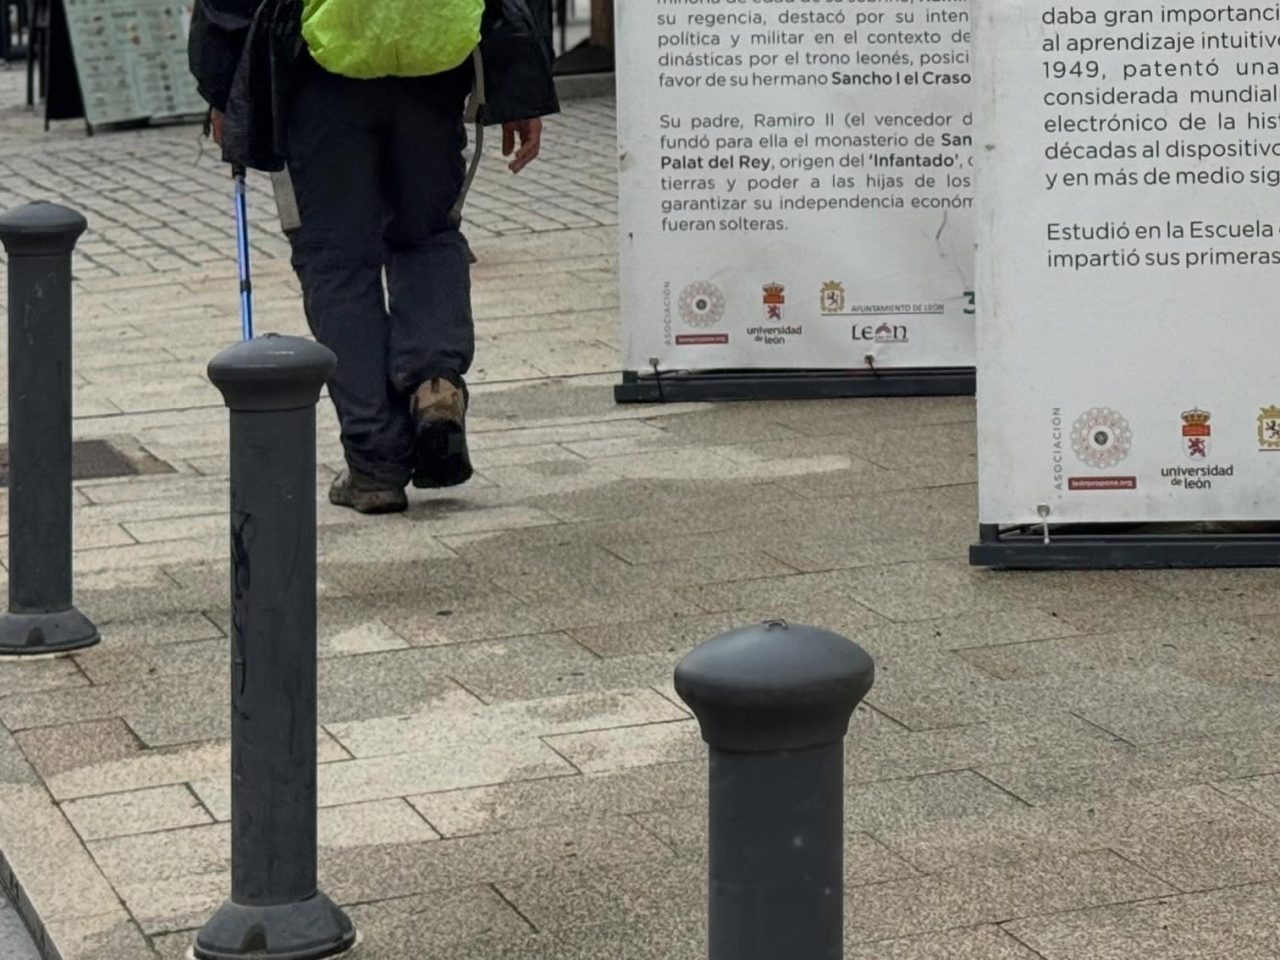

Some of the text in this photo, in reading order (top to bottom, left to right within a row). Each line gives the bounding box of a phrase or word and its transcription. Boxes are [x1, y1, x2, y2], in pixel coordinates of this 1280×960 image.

[661, 216, 788, 232] fueran solteras.
[1047, 248, 1140, 271] impartió
[1145, 252, 1180, 266] sus
[747, 326, 802, 335] universidad
[764, 335, 785, 344] león
[1161, 465, 1234, 477] universidad
[1171, 477, 1211, 490] de león
